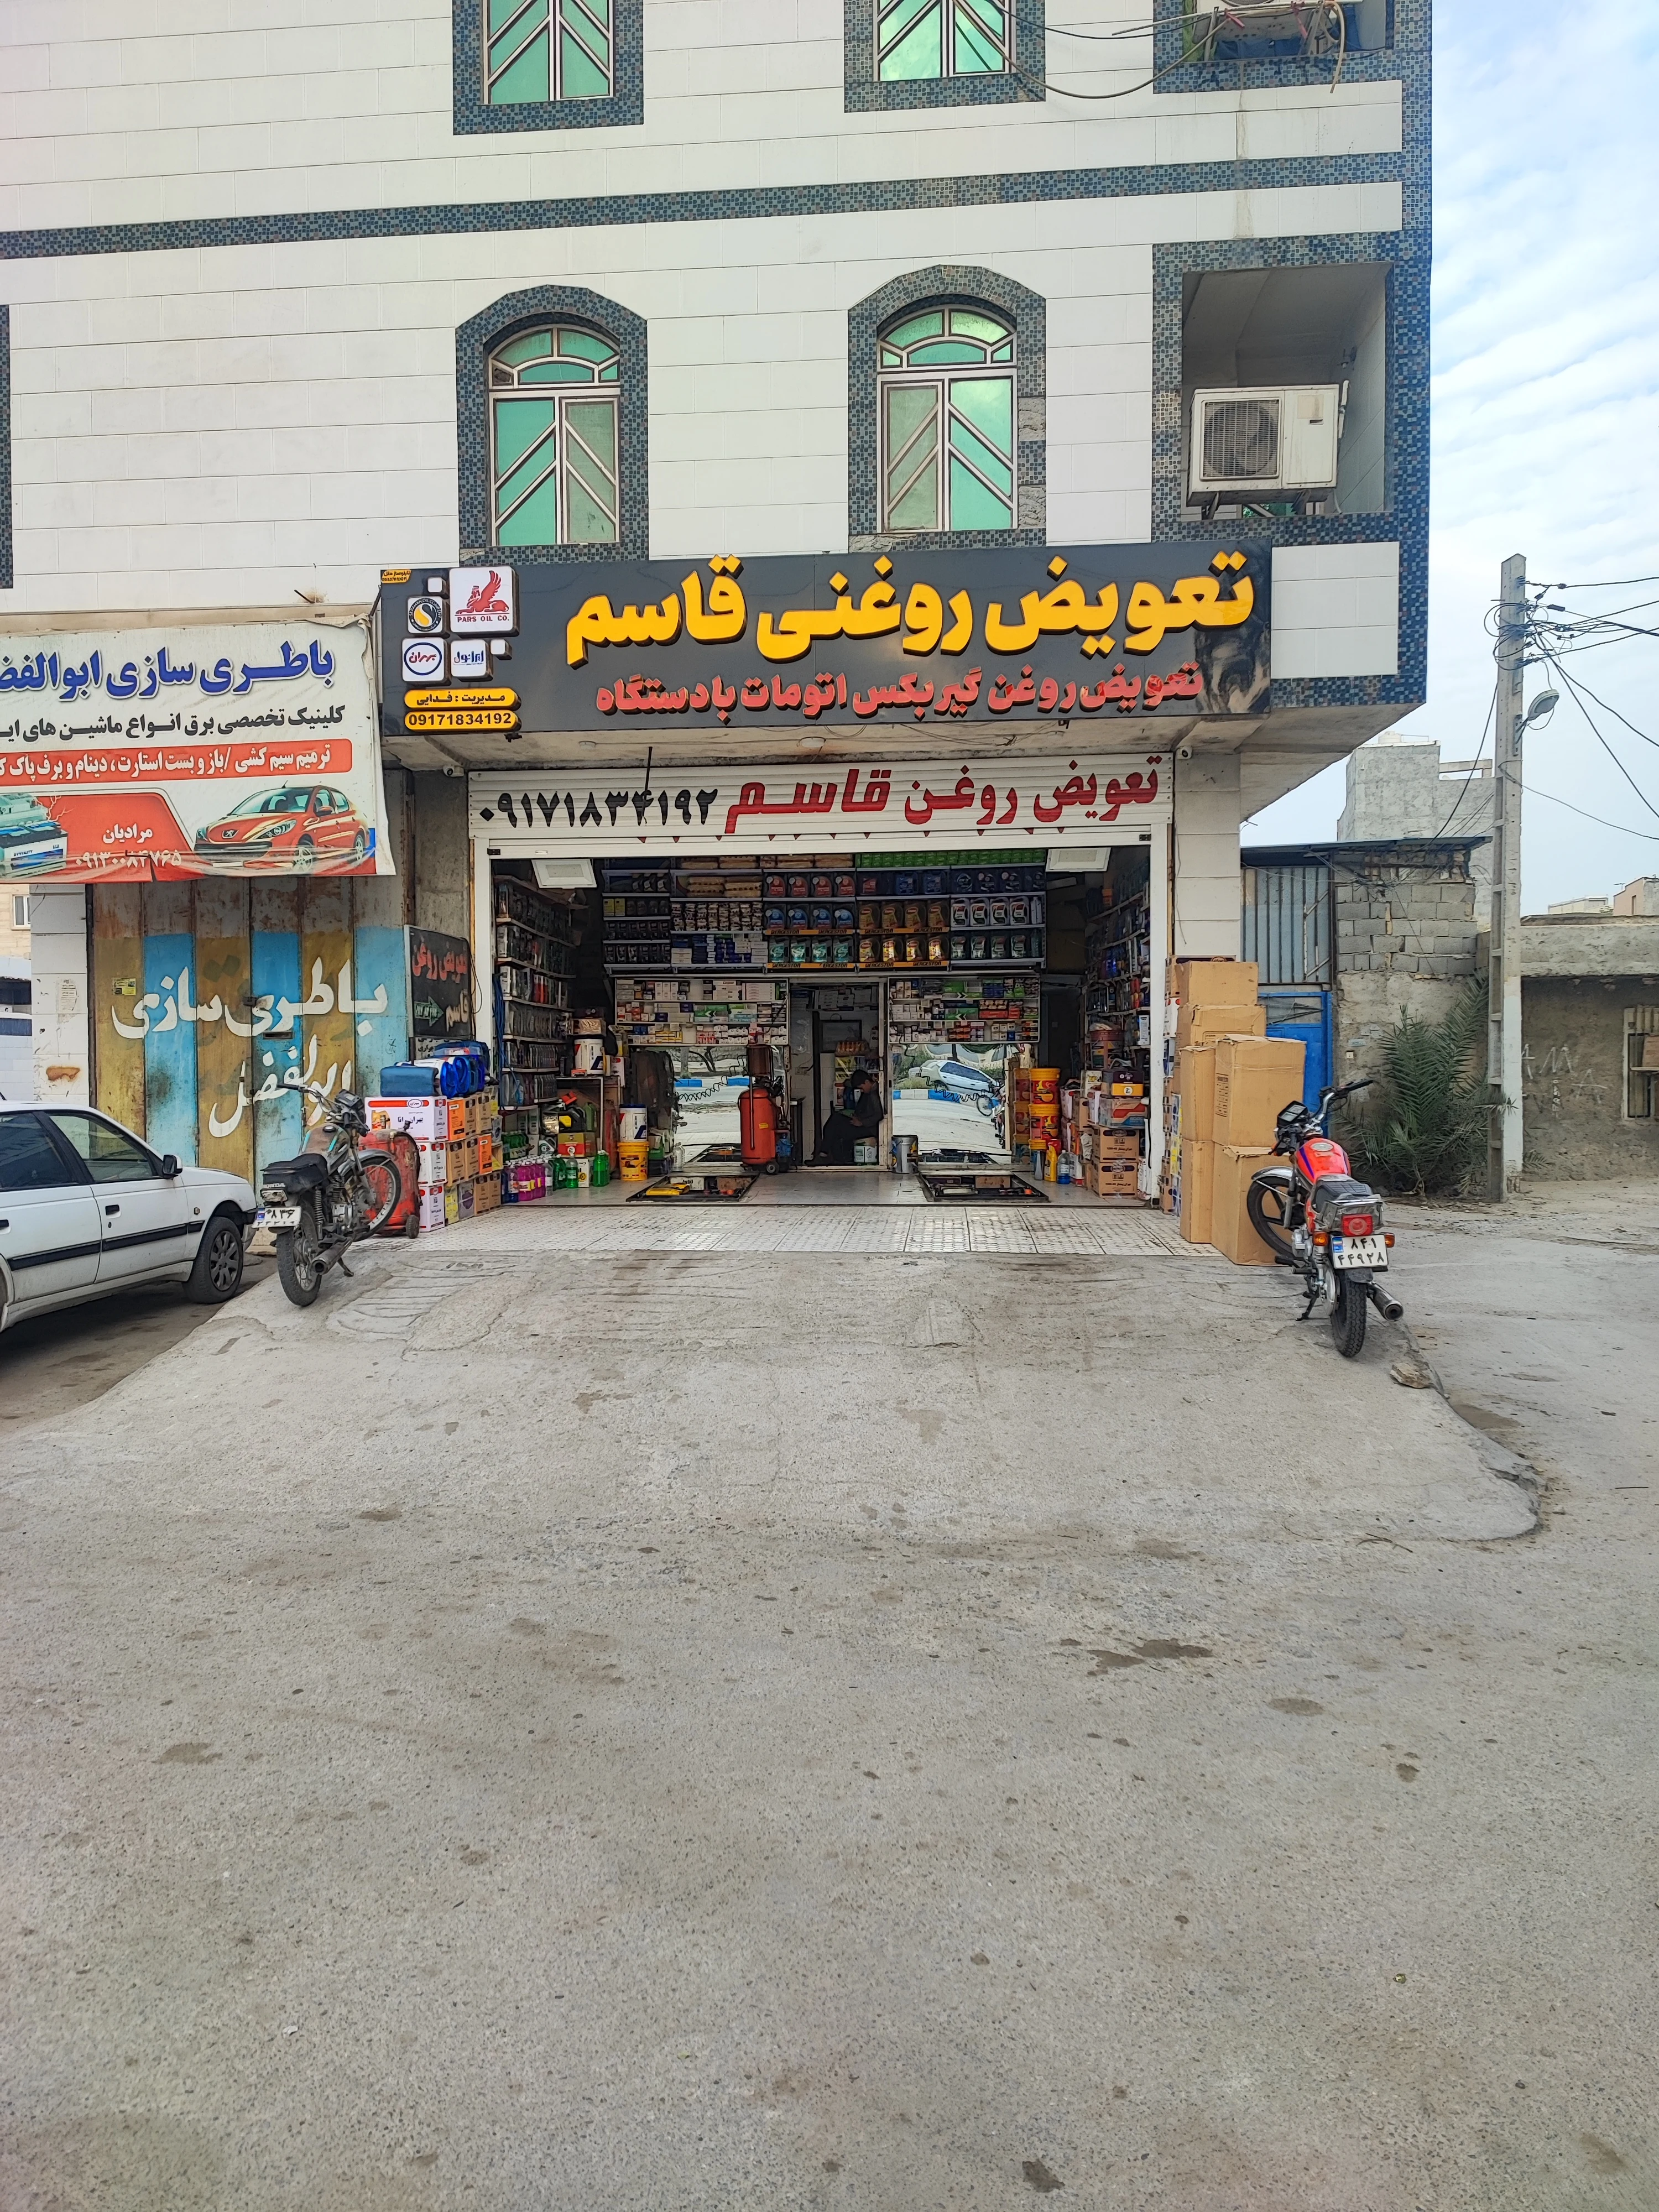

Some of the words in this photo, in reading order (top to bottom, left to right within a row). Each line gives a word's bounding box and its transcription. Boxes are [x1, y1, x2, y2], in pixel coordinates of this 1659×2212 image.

[567, 554, 747, 665] قاسم
[757, 556, 973, 660] روغنی
[985, 551, 1254, 656] تعویض
[0, 649, 101, 700] ابوالفض
[105, 646, 194, 697] سازی
[199, 639, 334, 693] باطری
[416, 691, 453, 706] فدایی
[461, 693, 505, 705] مدیریت
[741, 671, 847, 719] اتومات
[988, 664, 1076, 714] روغن
[1079, 660, 1203, 714] تعویض
[23, 717, 56, 743] های
[59, 714, 123, 741] ماشین
[126, 712, 181, 739] انواع
[184, 715, 215, 737] برق
[217, 708, 285, 735] تخصصی
[288, 705, 346, 729] کلینیک
[408, 712, 512, 726] 09171834192
[9, 754, 35, 782] پاک
[36, 753, 64, 781] برف
[65, 761, 74, 780] و
[75, 753, 108, 780] دینام
[165, 754, 195, 775] بست
[196, 757, 205, 775] و
[235, 746, 268, 774] کشی
[269, 751, 295, 773] سیم
[295, 744, 331, 770] ترمیم
[724, 769, 892, 834] قاسم
[904, 765, 1018, 826] روغن
[1032, 755, 1163, 824] تعویض
[478, 787, 719, 829] ۰۹۱۷۱۸۳۴۱۹۲
[102, 823, 154, 845] مرادیان
[111, 966, 223, 1040] سازی
[225, 957, 388, 1037] باطری
[1351, 1237, 1377, 1250] ۸۴۱
[1338, 1251, 1385, 1266] ۴۴۹۲۸
